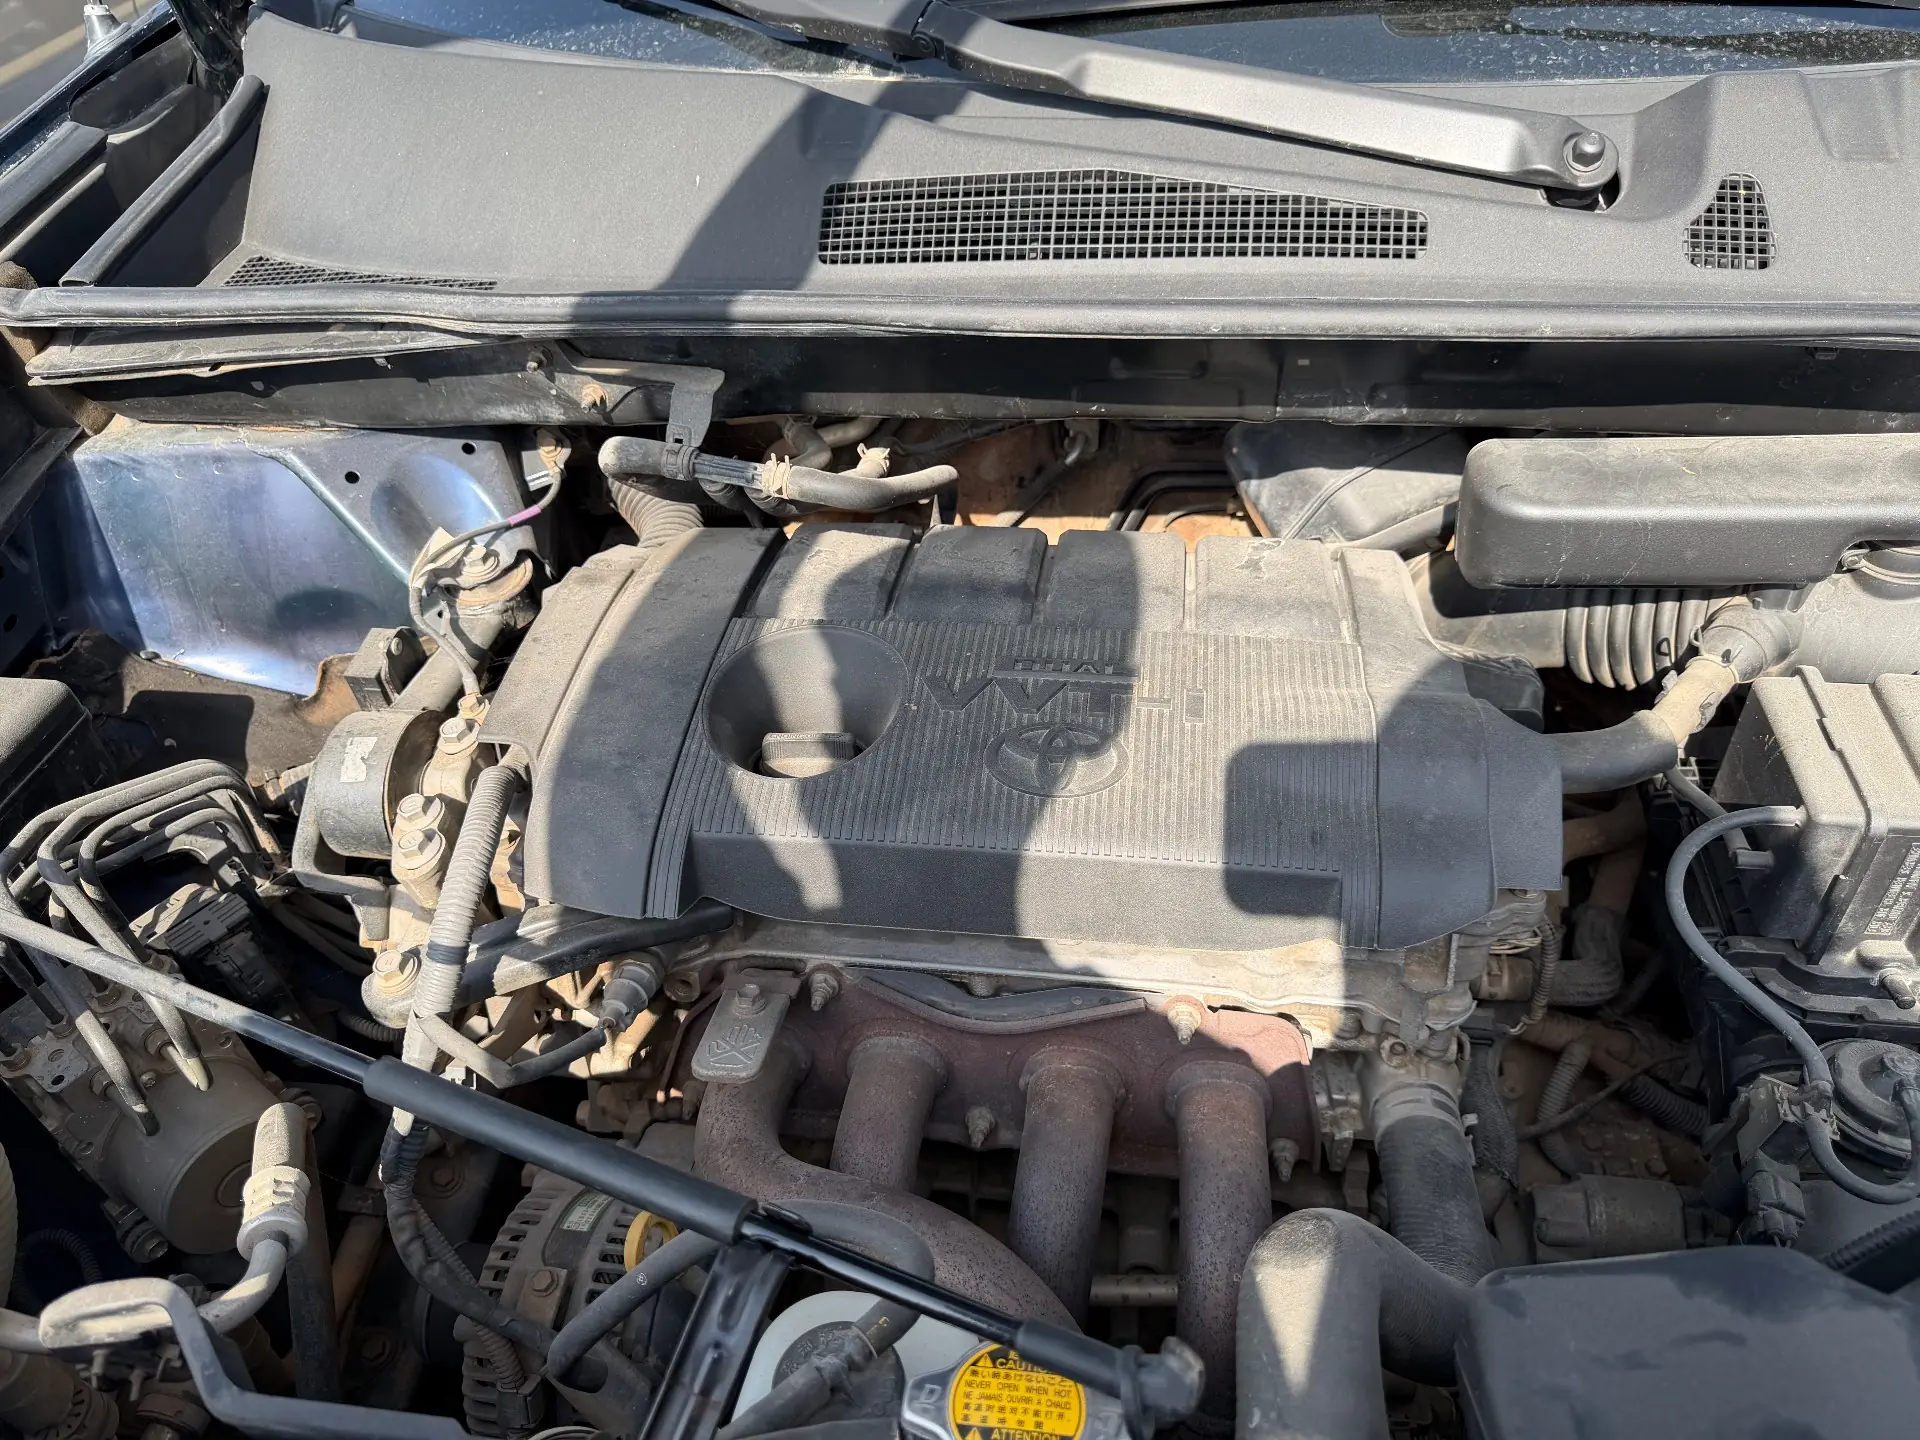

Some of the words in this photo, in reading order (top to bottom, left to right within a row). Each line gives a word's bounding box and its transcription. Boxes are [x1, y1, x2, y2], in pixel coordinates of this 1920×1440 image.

[964, 1380, 992, 1390] NEVER
[997, 1382, 1019, 1392] OPEN
[1025, 1385, 1048, 1395] WHEN
[963, 1391, 974, 1400] NE
[976, 1392, 1003, 1402] JAMAIS
[1007, 1395, 1033, 1405] OUVRIR
